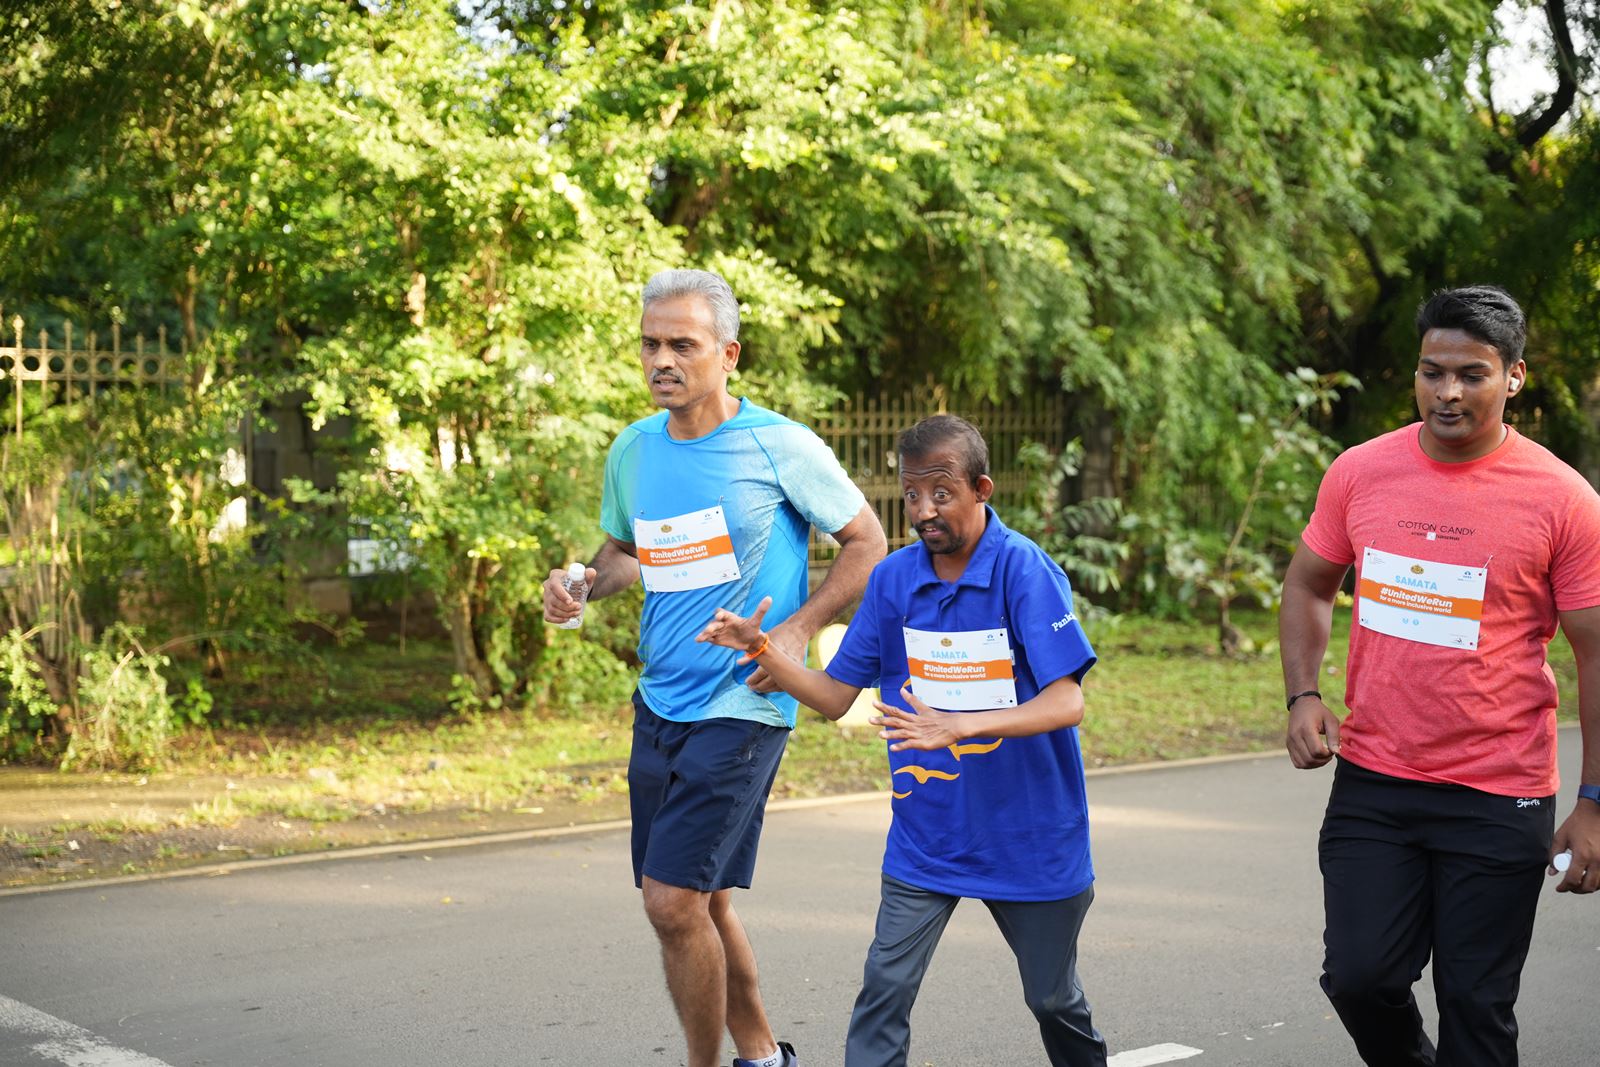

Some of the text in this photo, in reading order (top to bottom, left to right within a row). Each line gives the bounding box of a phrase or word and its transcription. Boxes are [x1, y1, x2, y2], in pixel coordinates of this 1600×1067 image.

[1397, 520, 1437, 532] COTTON
[1440, 525, 1476, 536] CANDY
[653, 534, 689, 546] SAMATA
[649, 545, 707, 559] #UnitedWeRun
[1394, 575, 1438, 591] SAMATA
[1380, 587, 1453, 608] #UnitedWeRun
[1391, 598, 1406, 606] more
[1406, 600, 1433, 611] inclusive
[1433, 606, 1452, 614] world
[930, 650, 968, 659] SAMATA
[923, 664, 985, 674] #UnitedWeRun
[1516, 798, 1540, 808] Sports
